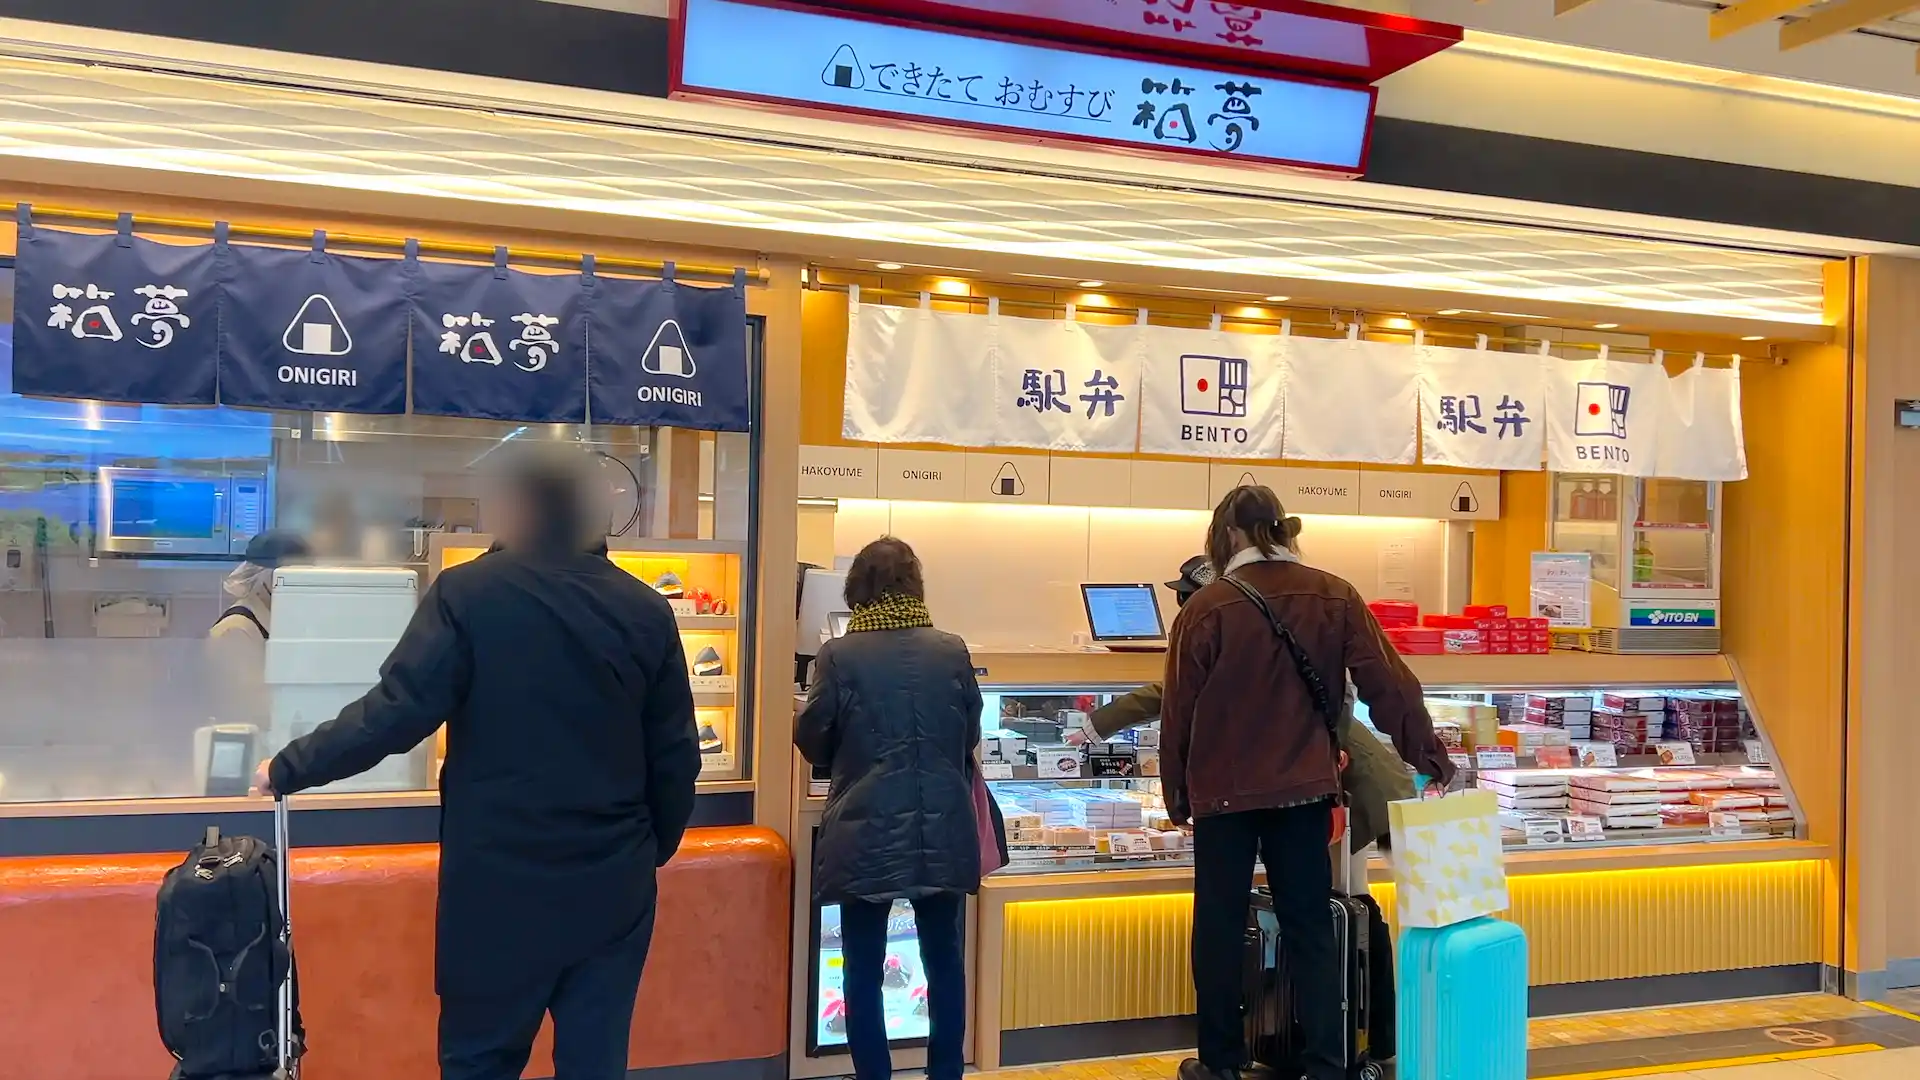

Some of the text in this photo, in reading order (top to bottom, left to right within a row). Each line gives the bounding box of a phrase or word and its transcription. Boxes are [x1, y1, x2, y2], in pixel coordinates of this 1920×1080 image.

[868, 59, 983, 104] できたて
[994, 75, 1114, 118] おむすび
[277, 365, 357, 387] ONIGIRI
[637, 386, 702, 407] ONIGIRI
[1017, 369, 1125, 419] 駅弁
[1437, 394, 1531, 440] 駅弁
[1181, 424, 1248, 444] BENTO
[1577, 445, 1630, 463] BENTO
[801, 466, 862, 478] HAKOYUME
[902, 470, 942, 481] ONIGIRI
[1298, 486, 1348, 497] HAKOYUME
[1379, 489, 1412, 500] ONIGIRI
